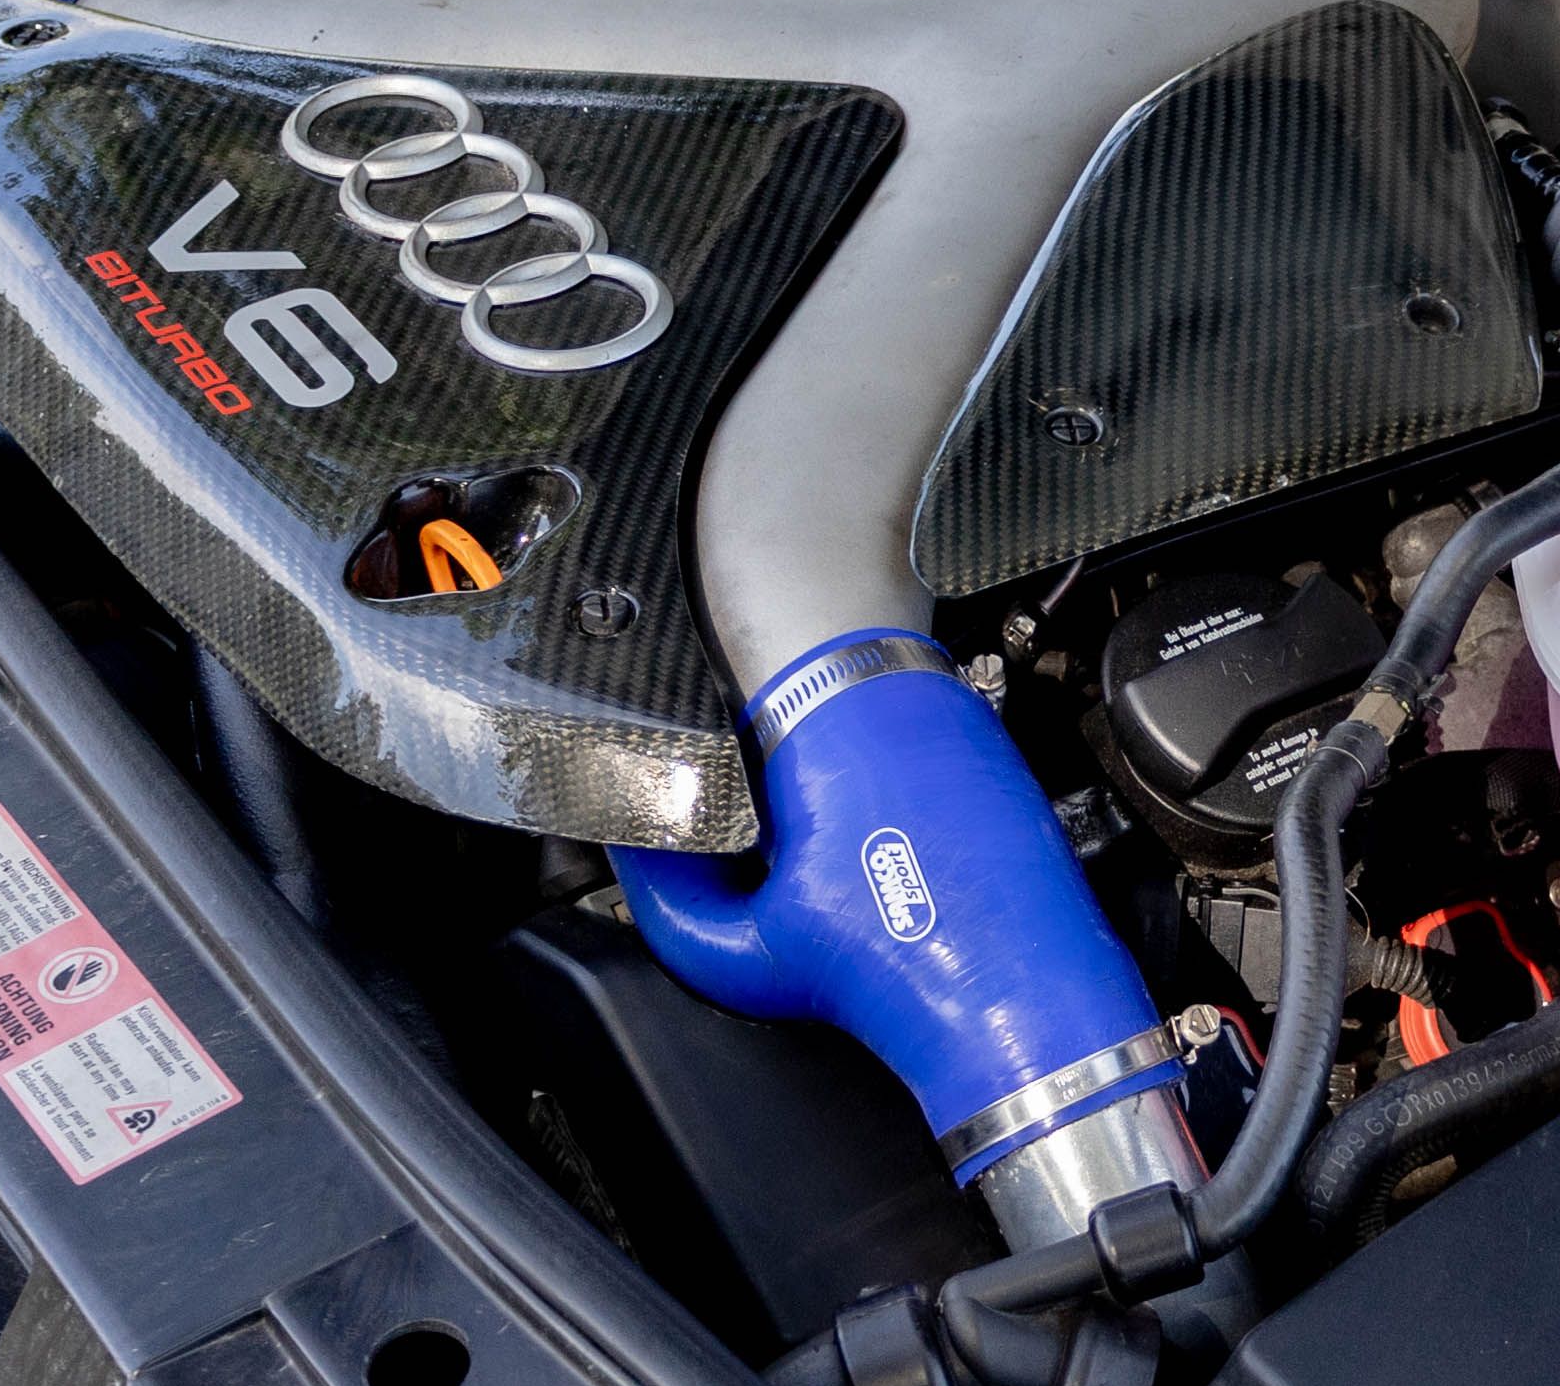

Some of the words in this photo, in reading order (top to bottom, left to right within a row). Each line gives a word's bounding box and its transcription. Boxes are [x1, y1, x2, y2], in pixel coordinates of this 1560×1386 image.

[148, 179, 398, 408] V6
[85, 250, 252, 416] BITURBO
[1248, 751, 1261, 762] To
[17, 856, 77, 920] HOCHSPANNUNG
[25, 891, 44, 906] der
[869, 849, 915, 933] SAMCO
[12, 901, 46, 935] abstellen
[66, 1040, 90, 1062] start
[101, 1082, 123, 1101] time
[81, 1031, 116, 1066] Radiator
[116, 1076, 140, 1097] may
[143, 1043, 177, 1077] anlaufen
[179, 1060, 205, 1083] kann
[37, 1071, 76, 1110] ventilateur
[65, 1109, 90, 1130] peut
[49, 1113, 72, 1132] tout
[62, 1129, 96, 1162] moment
